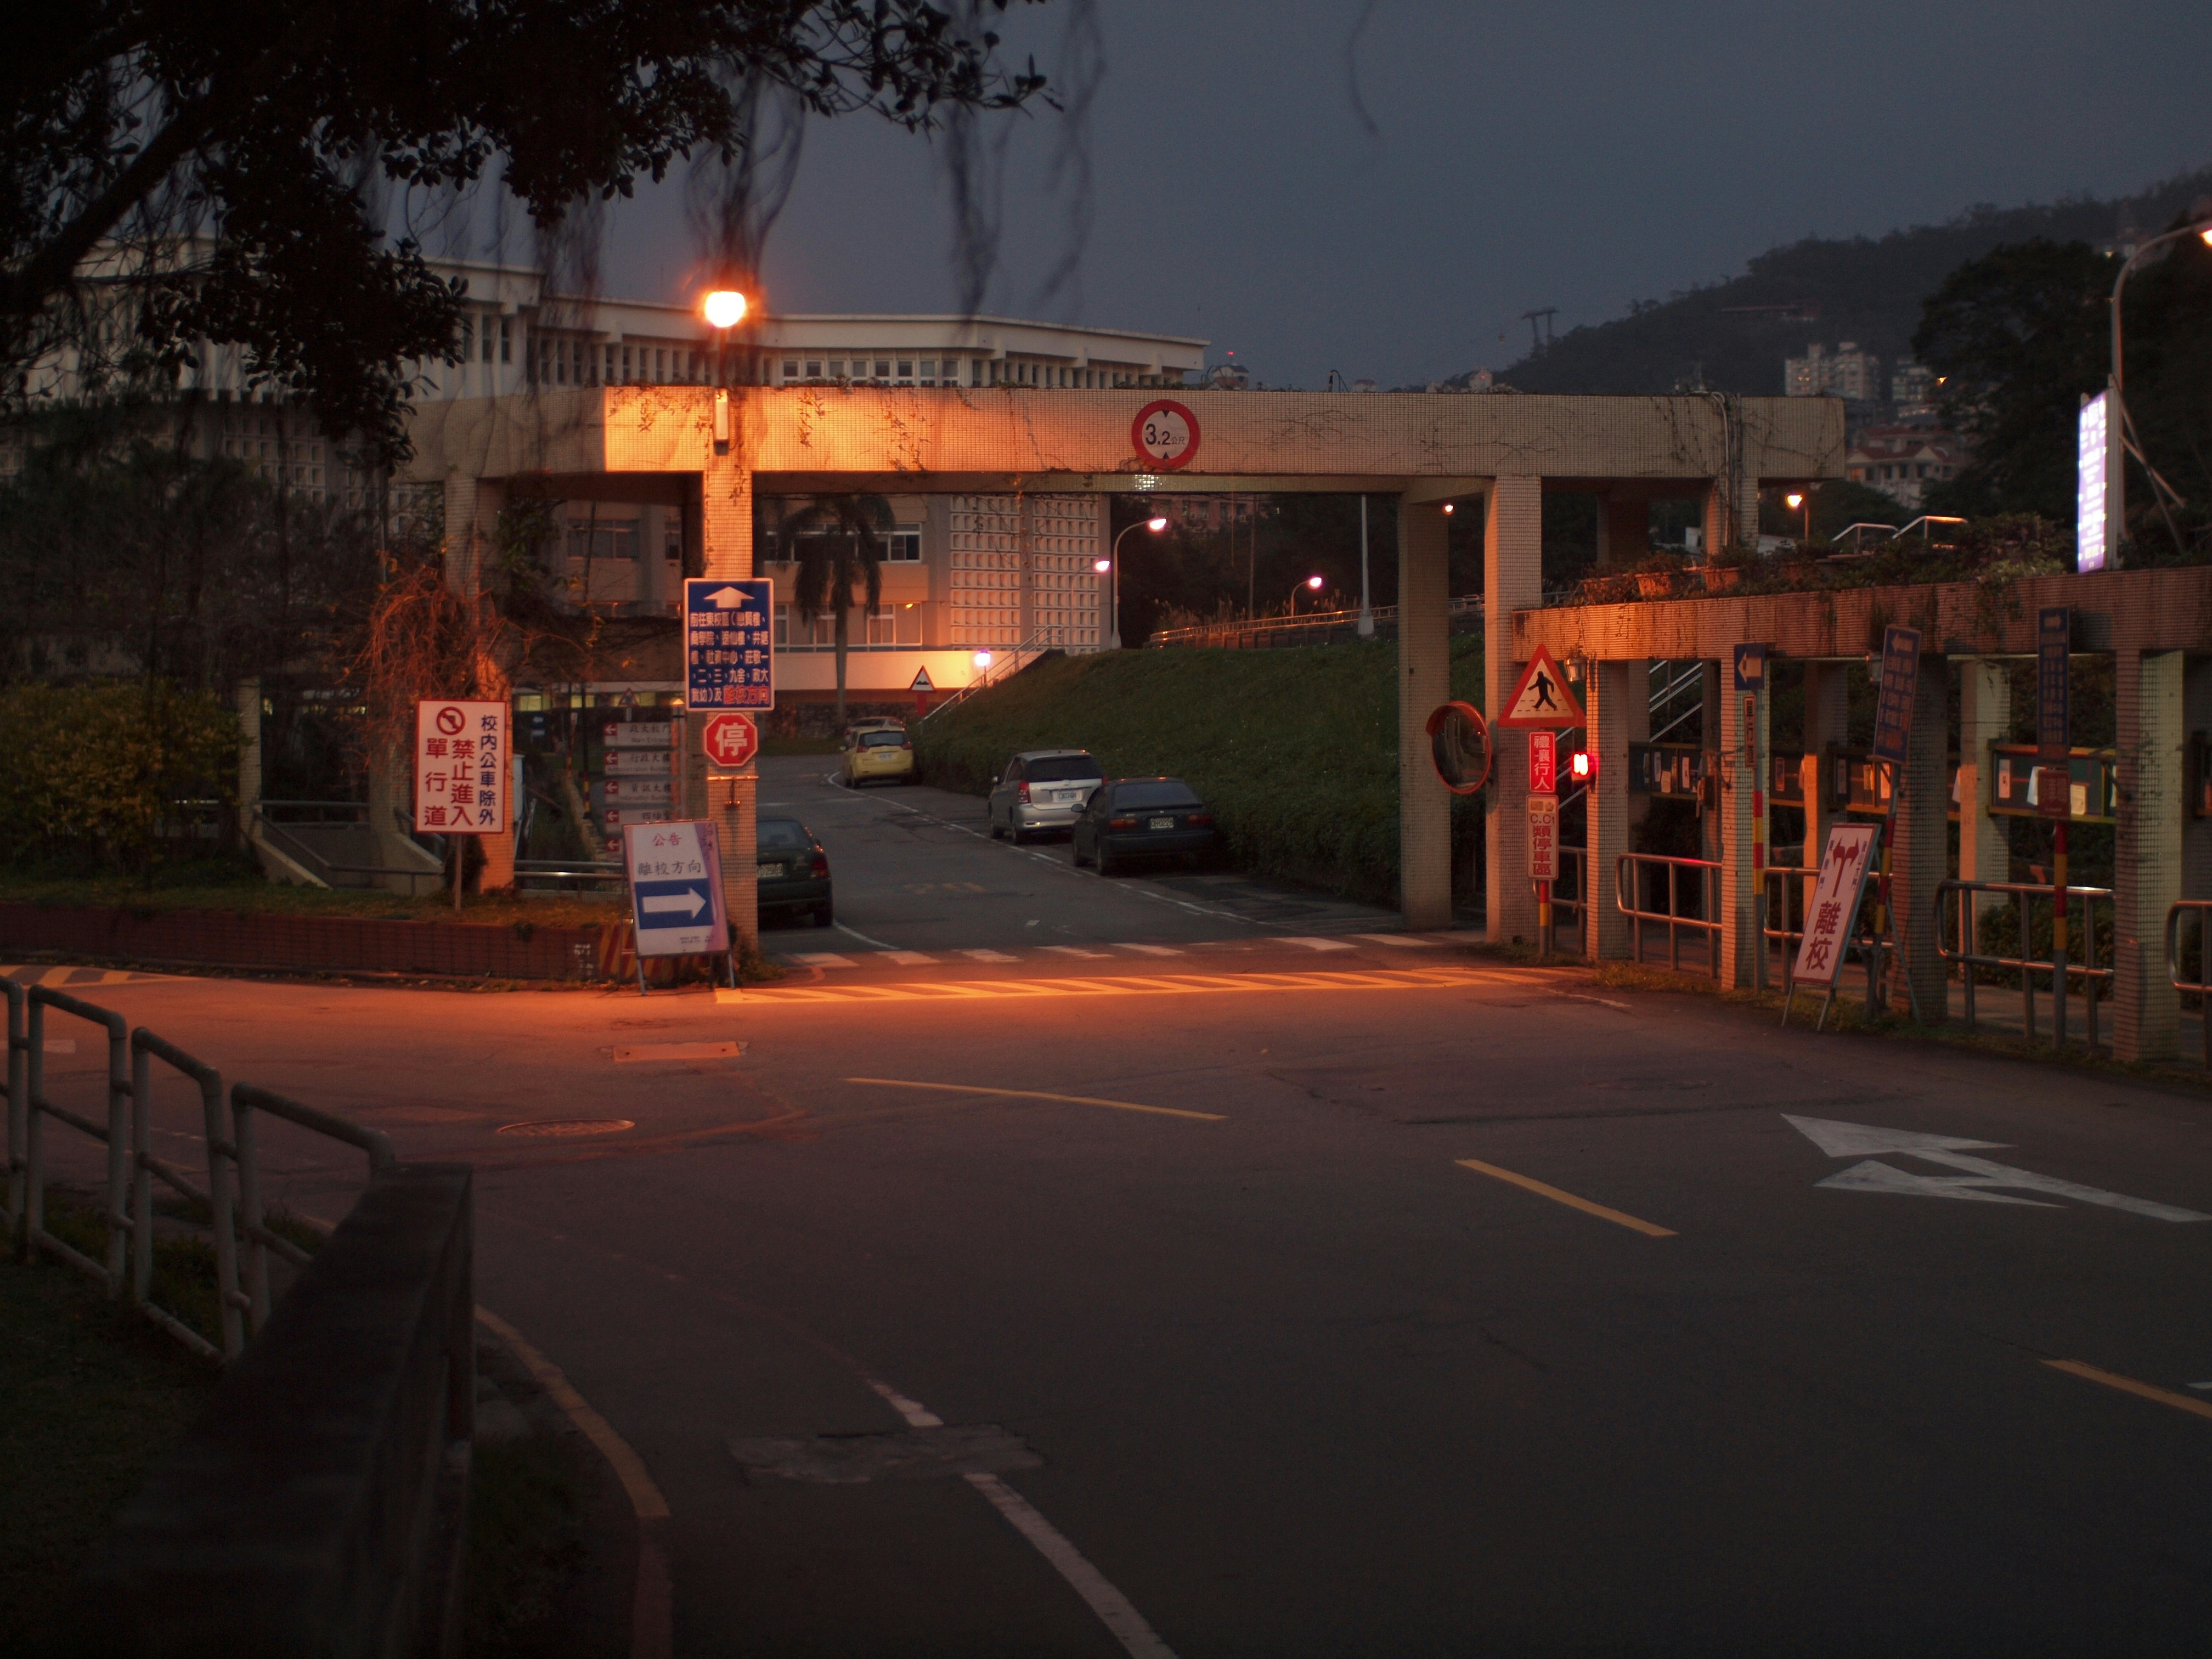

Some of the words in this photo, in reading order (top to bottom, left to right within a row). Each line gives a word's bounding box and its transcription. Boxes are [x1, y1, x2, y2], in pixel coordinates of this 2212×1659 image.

[479, 715, 498, 826] 校內公車除外
[715, 722, 748, 757] 停
[424, 737, 449, 826] 單行道
[451, 739, 476, 826] 禁止進入
[637, 859, 701, 876] 離校方向
[652, 832, 682, 847] 公告
[1805, 900, 1842, 970] 離校
